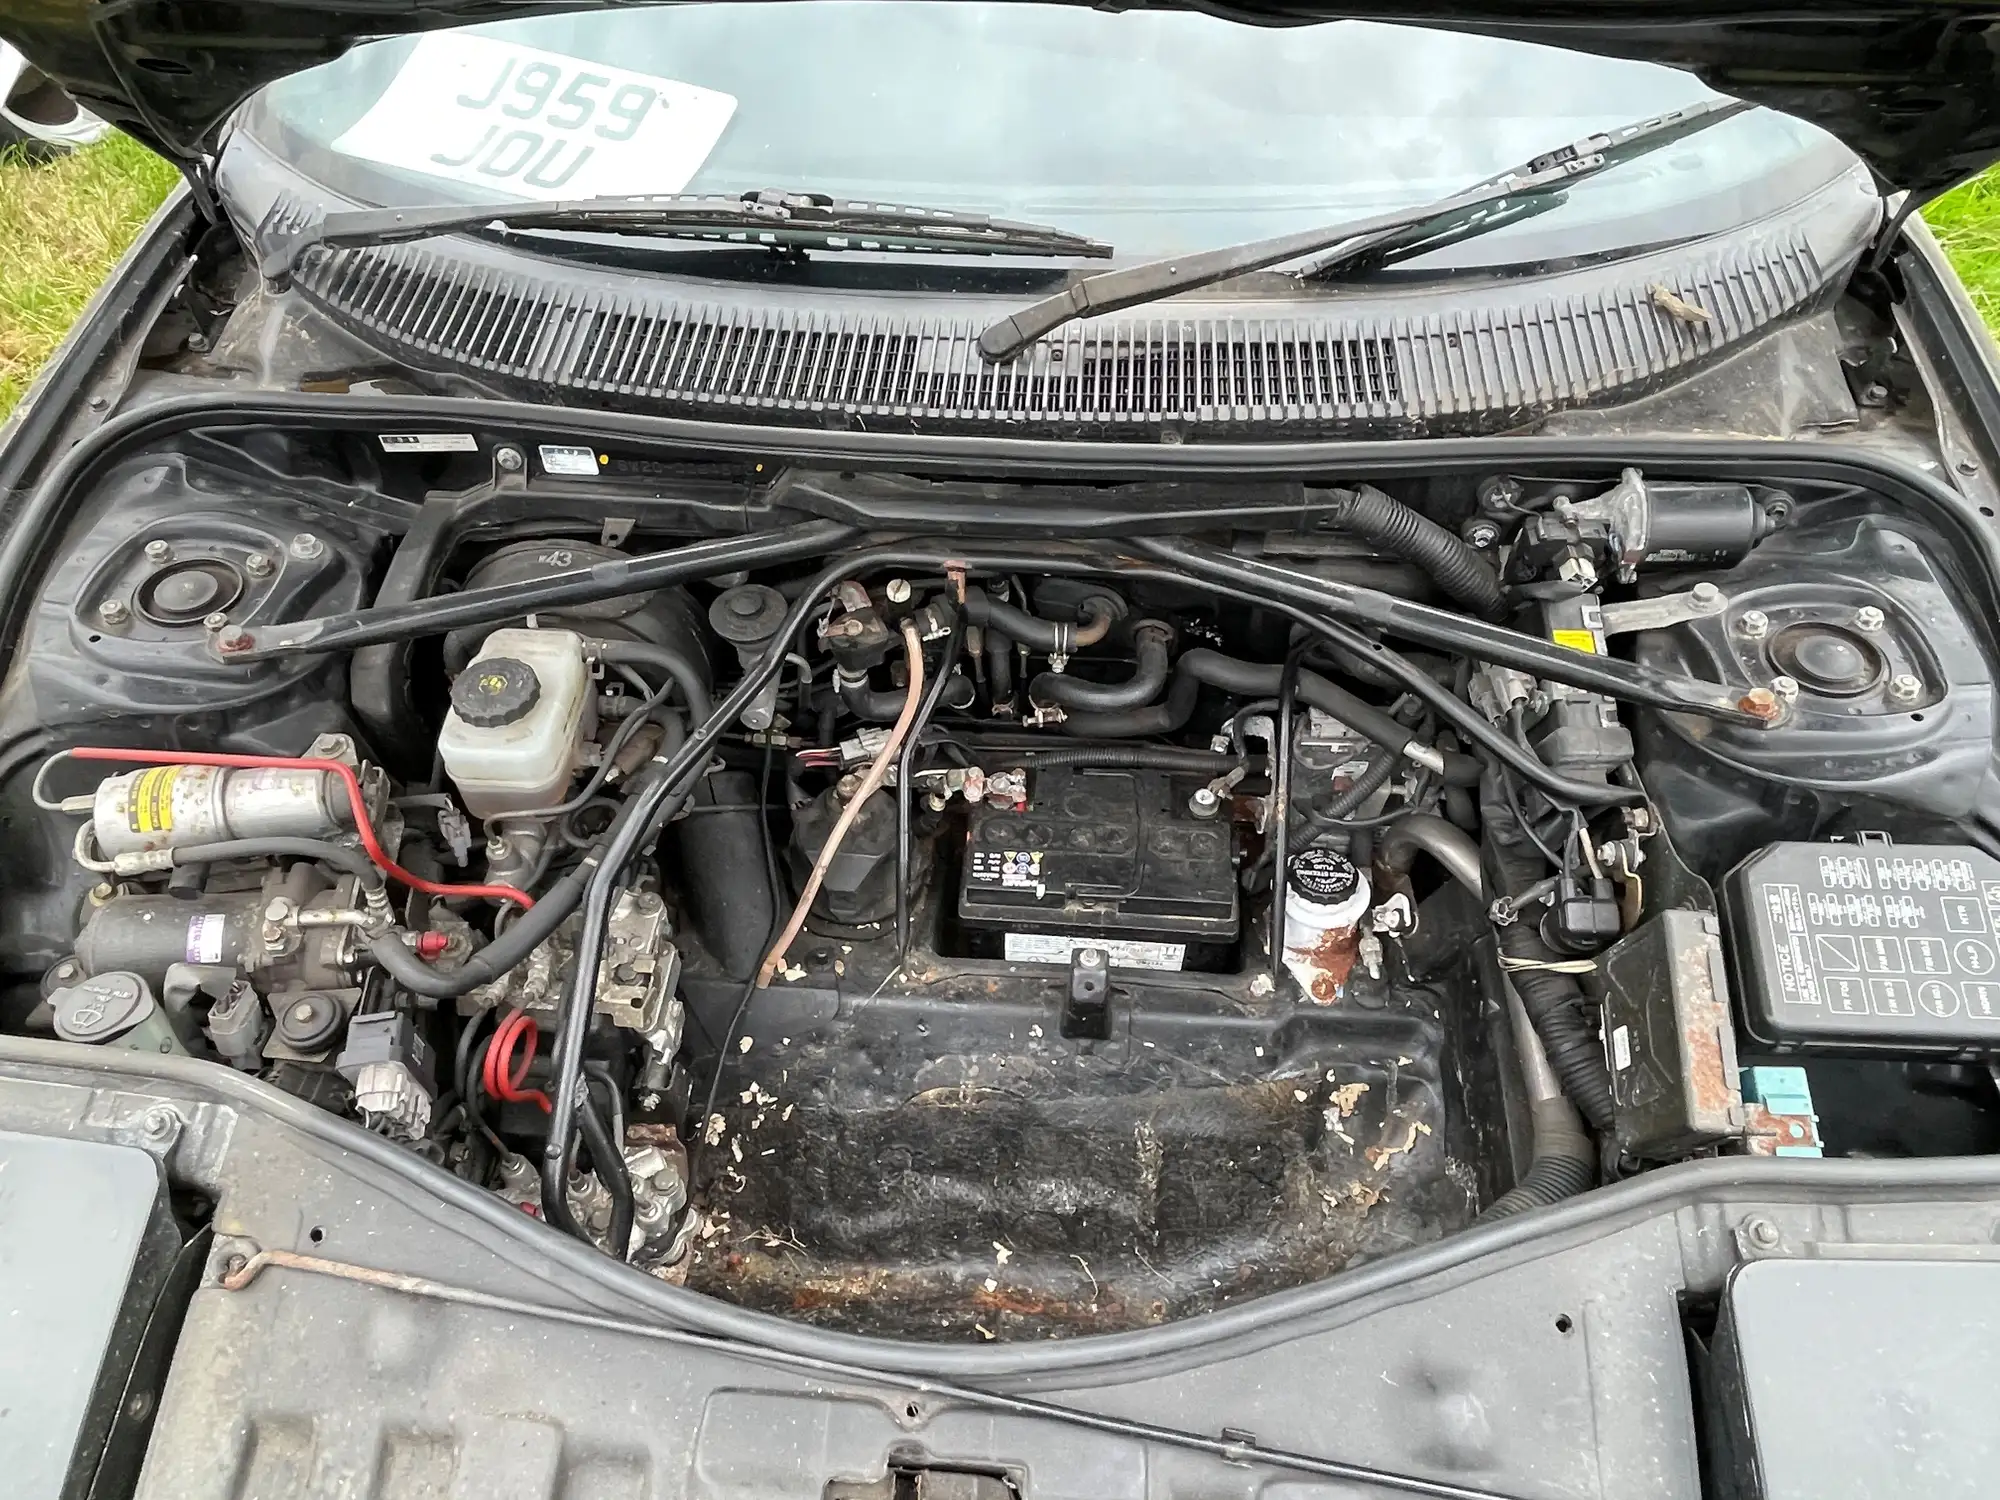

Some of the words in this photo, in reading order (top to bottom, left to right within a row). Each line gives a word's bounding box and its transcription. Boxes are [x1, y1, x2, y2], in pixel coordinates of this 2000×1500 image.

[456, 58, 656, 141] J959
[1296, 869, 1329, 878] STEERING
[1956, 904, 1970, 925] HTR
[1777, 943, 1796, 992] NOTICE
[1878, 956, 1890, 971] FAN
[1925, 957, 1936, 972] FAN
[1888, 999, 1899, 1013] FAN
[1935, 999, 1946, 1015] FAN
